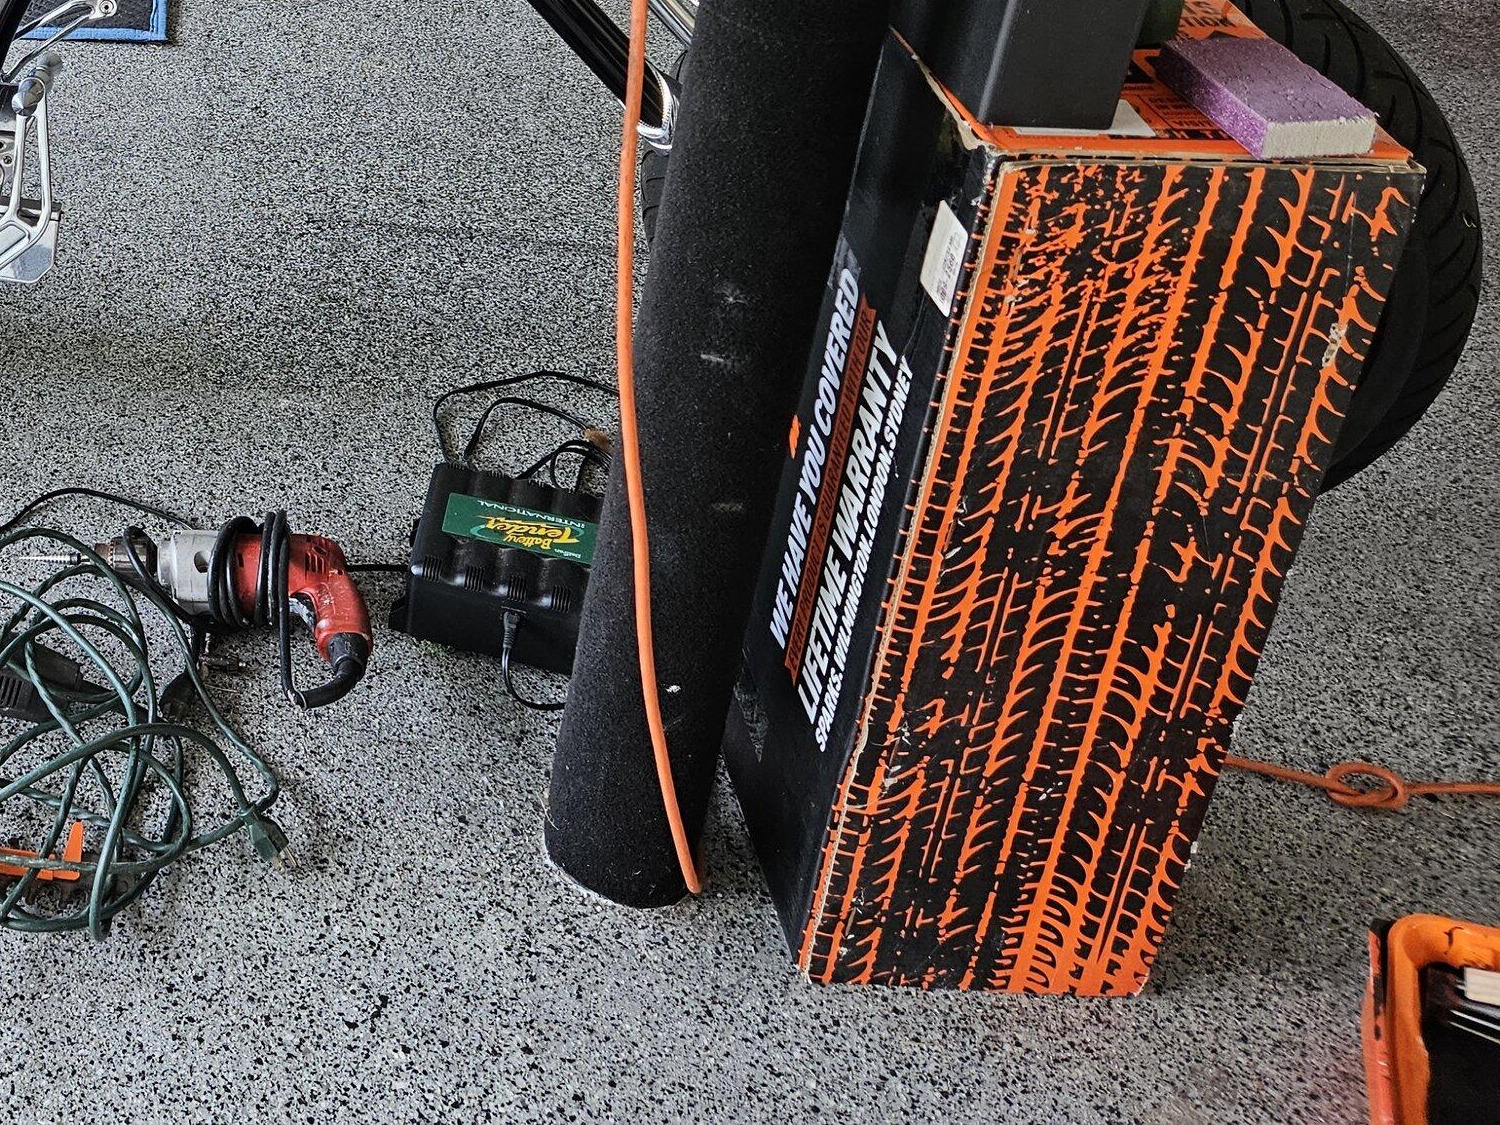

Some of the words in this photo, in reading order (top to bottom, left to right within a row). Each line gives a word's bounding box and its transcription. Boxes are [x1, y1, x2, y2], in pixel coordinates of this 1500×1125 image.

[814, 268, 859, 436] COVERED
[853, 310, 875, 355] OUR
[884, 355, 913, 451] SYDNEY
[798, 424, 826, 505] YOU
[477, 500, 585, 528] INTERNATIONAL
[485, 518, 581, 545] Tender
[503, 533, 552, 550] Battery
[781, 492, 812, 597] HAVE
[798, 545, 847, 724] LIFETIME
[832, 320, 898, 562] WARRANTY
[770, 578, 793, 650] WE
